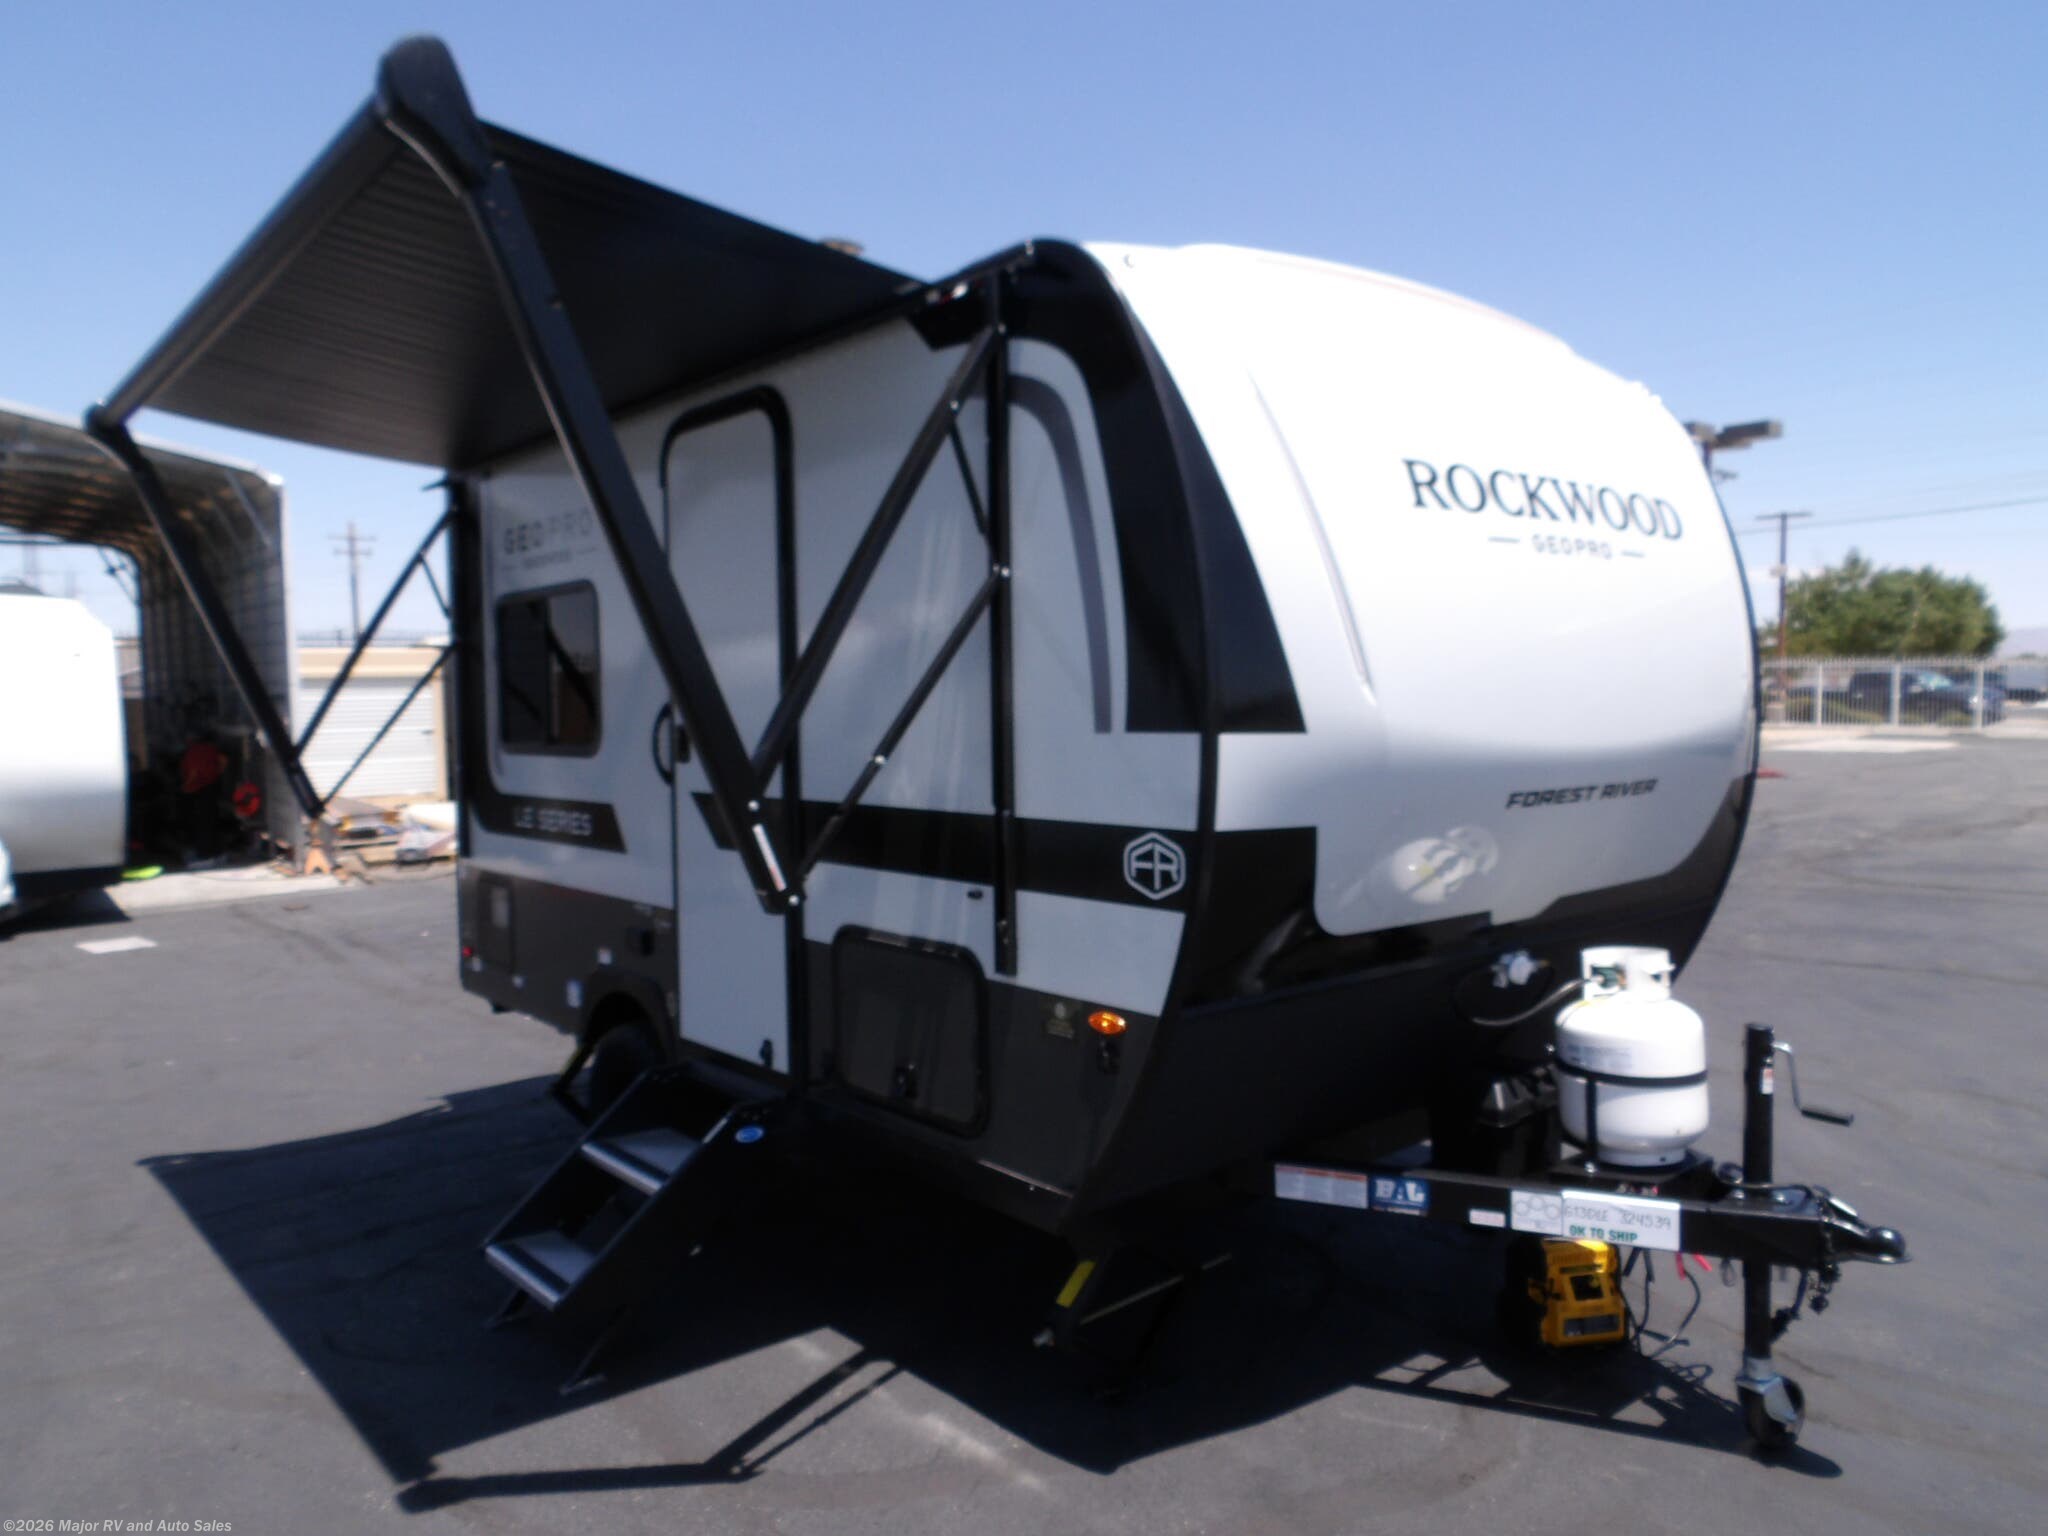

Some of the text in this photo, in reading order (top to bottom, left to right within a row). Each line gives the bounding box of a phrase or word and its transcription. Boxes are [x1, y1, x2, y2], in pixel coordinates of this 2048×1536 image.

[1402, 458, 1683, 540] ROCKWOOD
[1531, 534, 1613, 560] GEOPRO
[1505, 779, 1659, 809] FOREST RIVER
[539, 810, 592, 836] SERIES
[1569, 1224, 1638, 1243] OK TO SHIP
